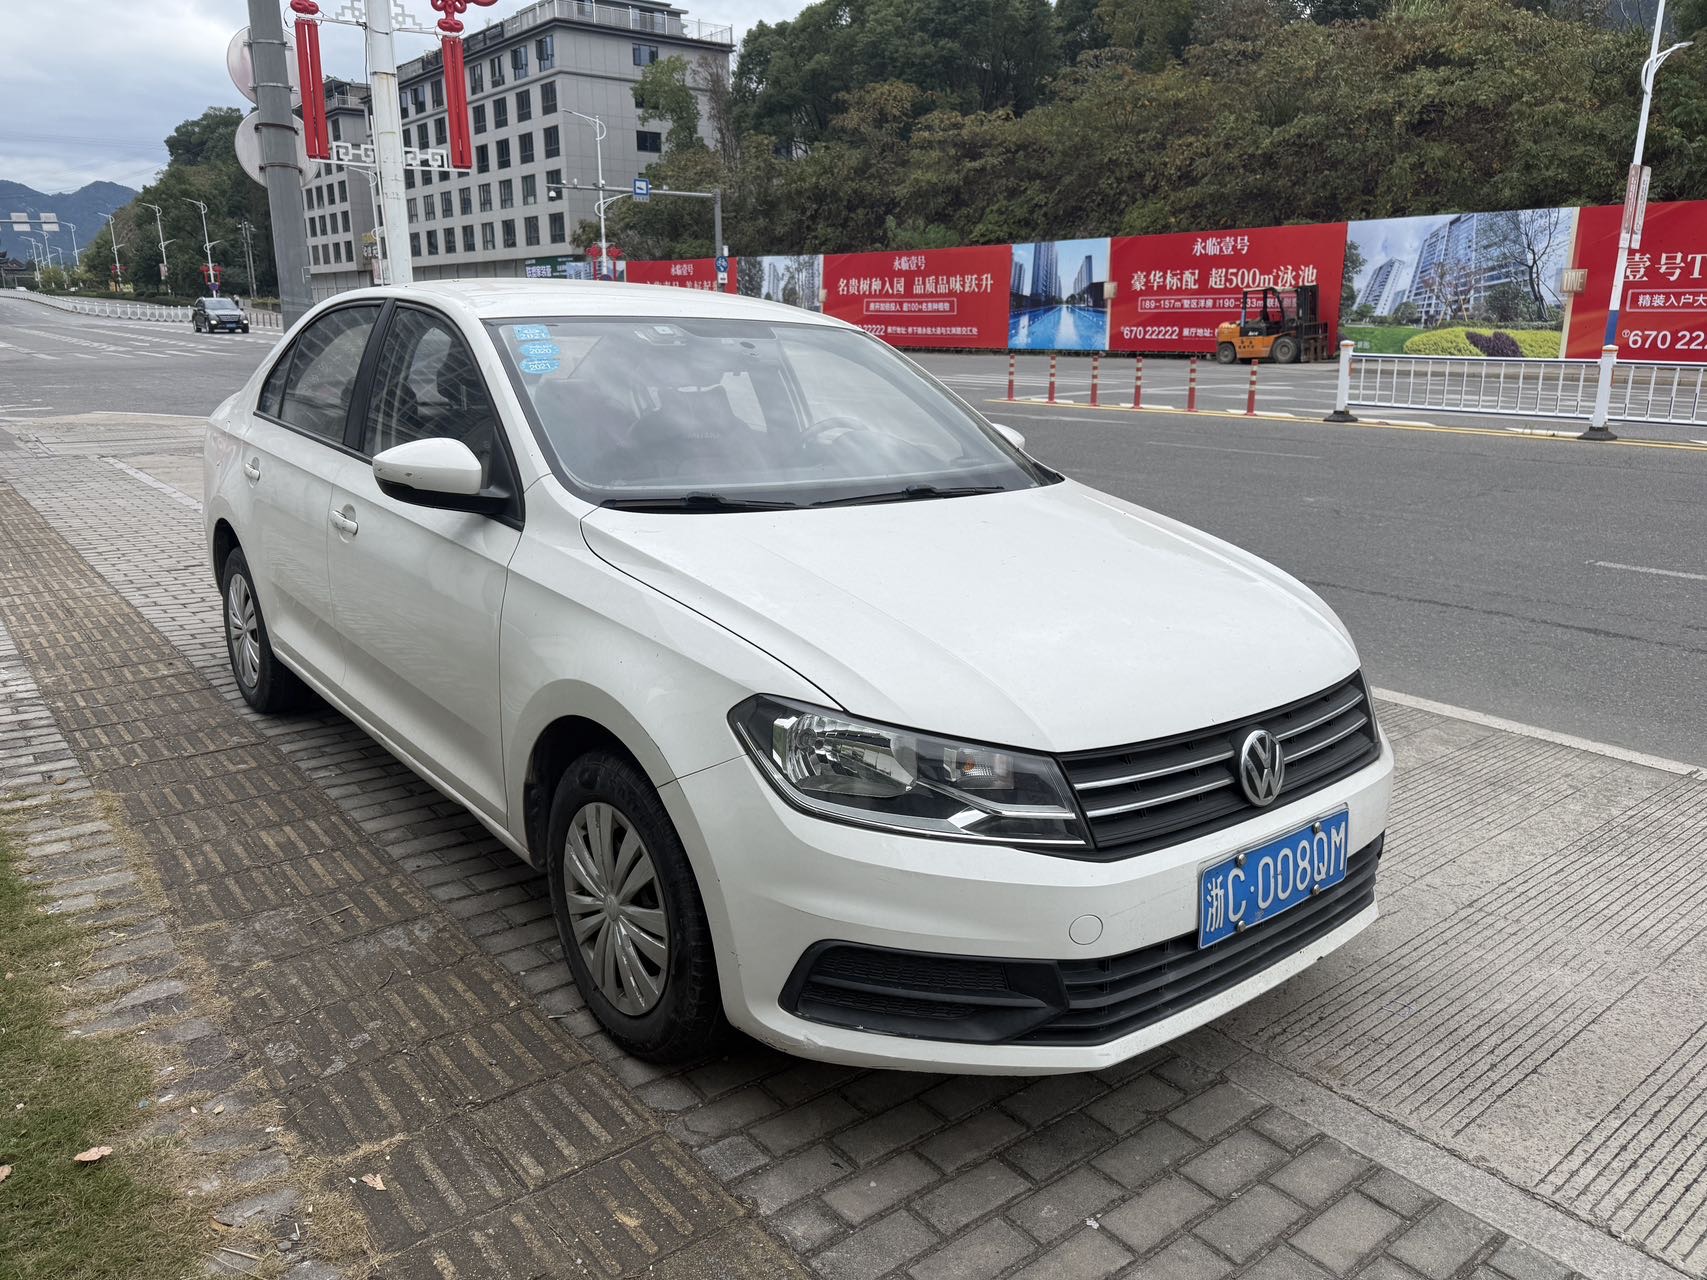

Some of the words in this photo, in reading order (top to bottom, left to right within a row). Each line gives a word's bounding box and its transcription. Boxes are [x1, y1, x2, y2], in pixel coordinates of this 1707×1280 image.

[1192, 235, 1250, 256] 永临壹号
[893, 255, 926, 271] 永临壹号
[837, 277, 905, 295] 名贵树种入园
[913, 273, 994, 294] 品质品味跃升
[1131, 269, 1199, 292] 豪华标配
[1563, 271, 1585, 291] ONE
[1123, 326, 1144, 339] 670
[1145, 326, 1179, 339] 22222
[1628, 330, 1671, 349] 670
[1675, 330, 1707, 349] 22
